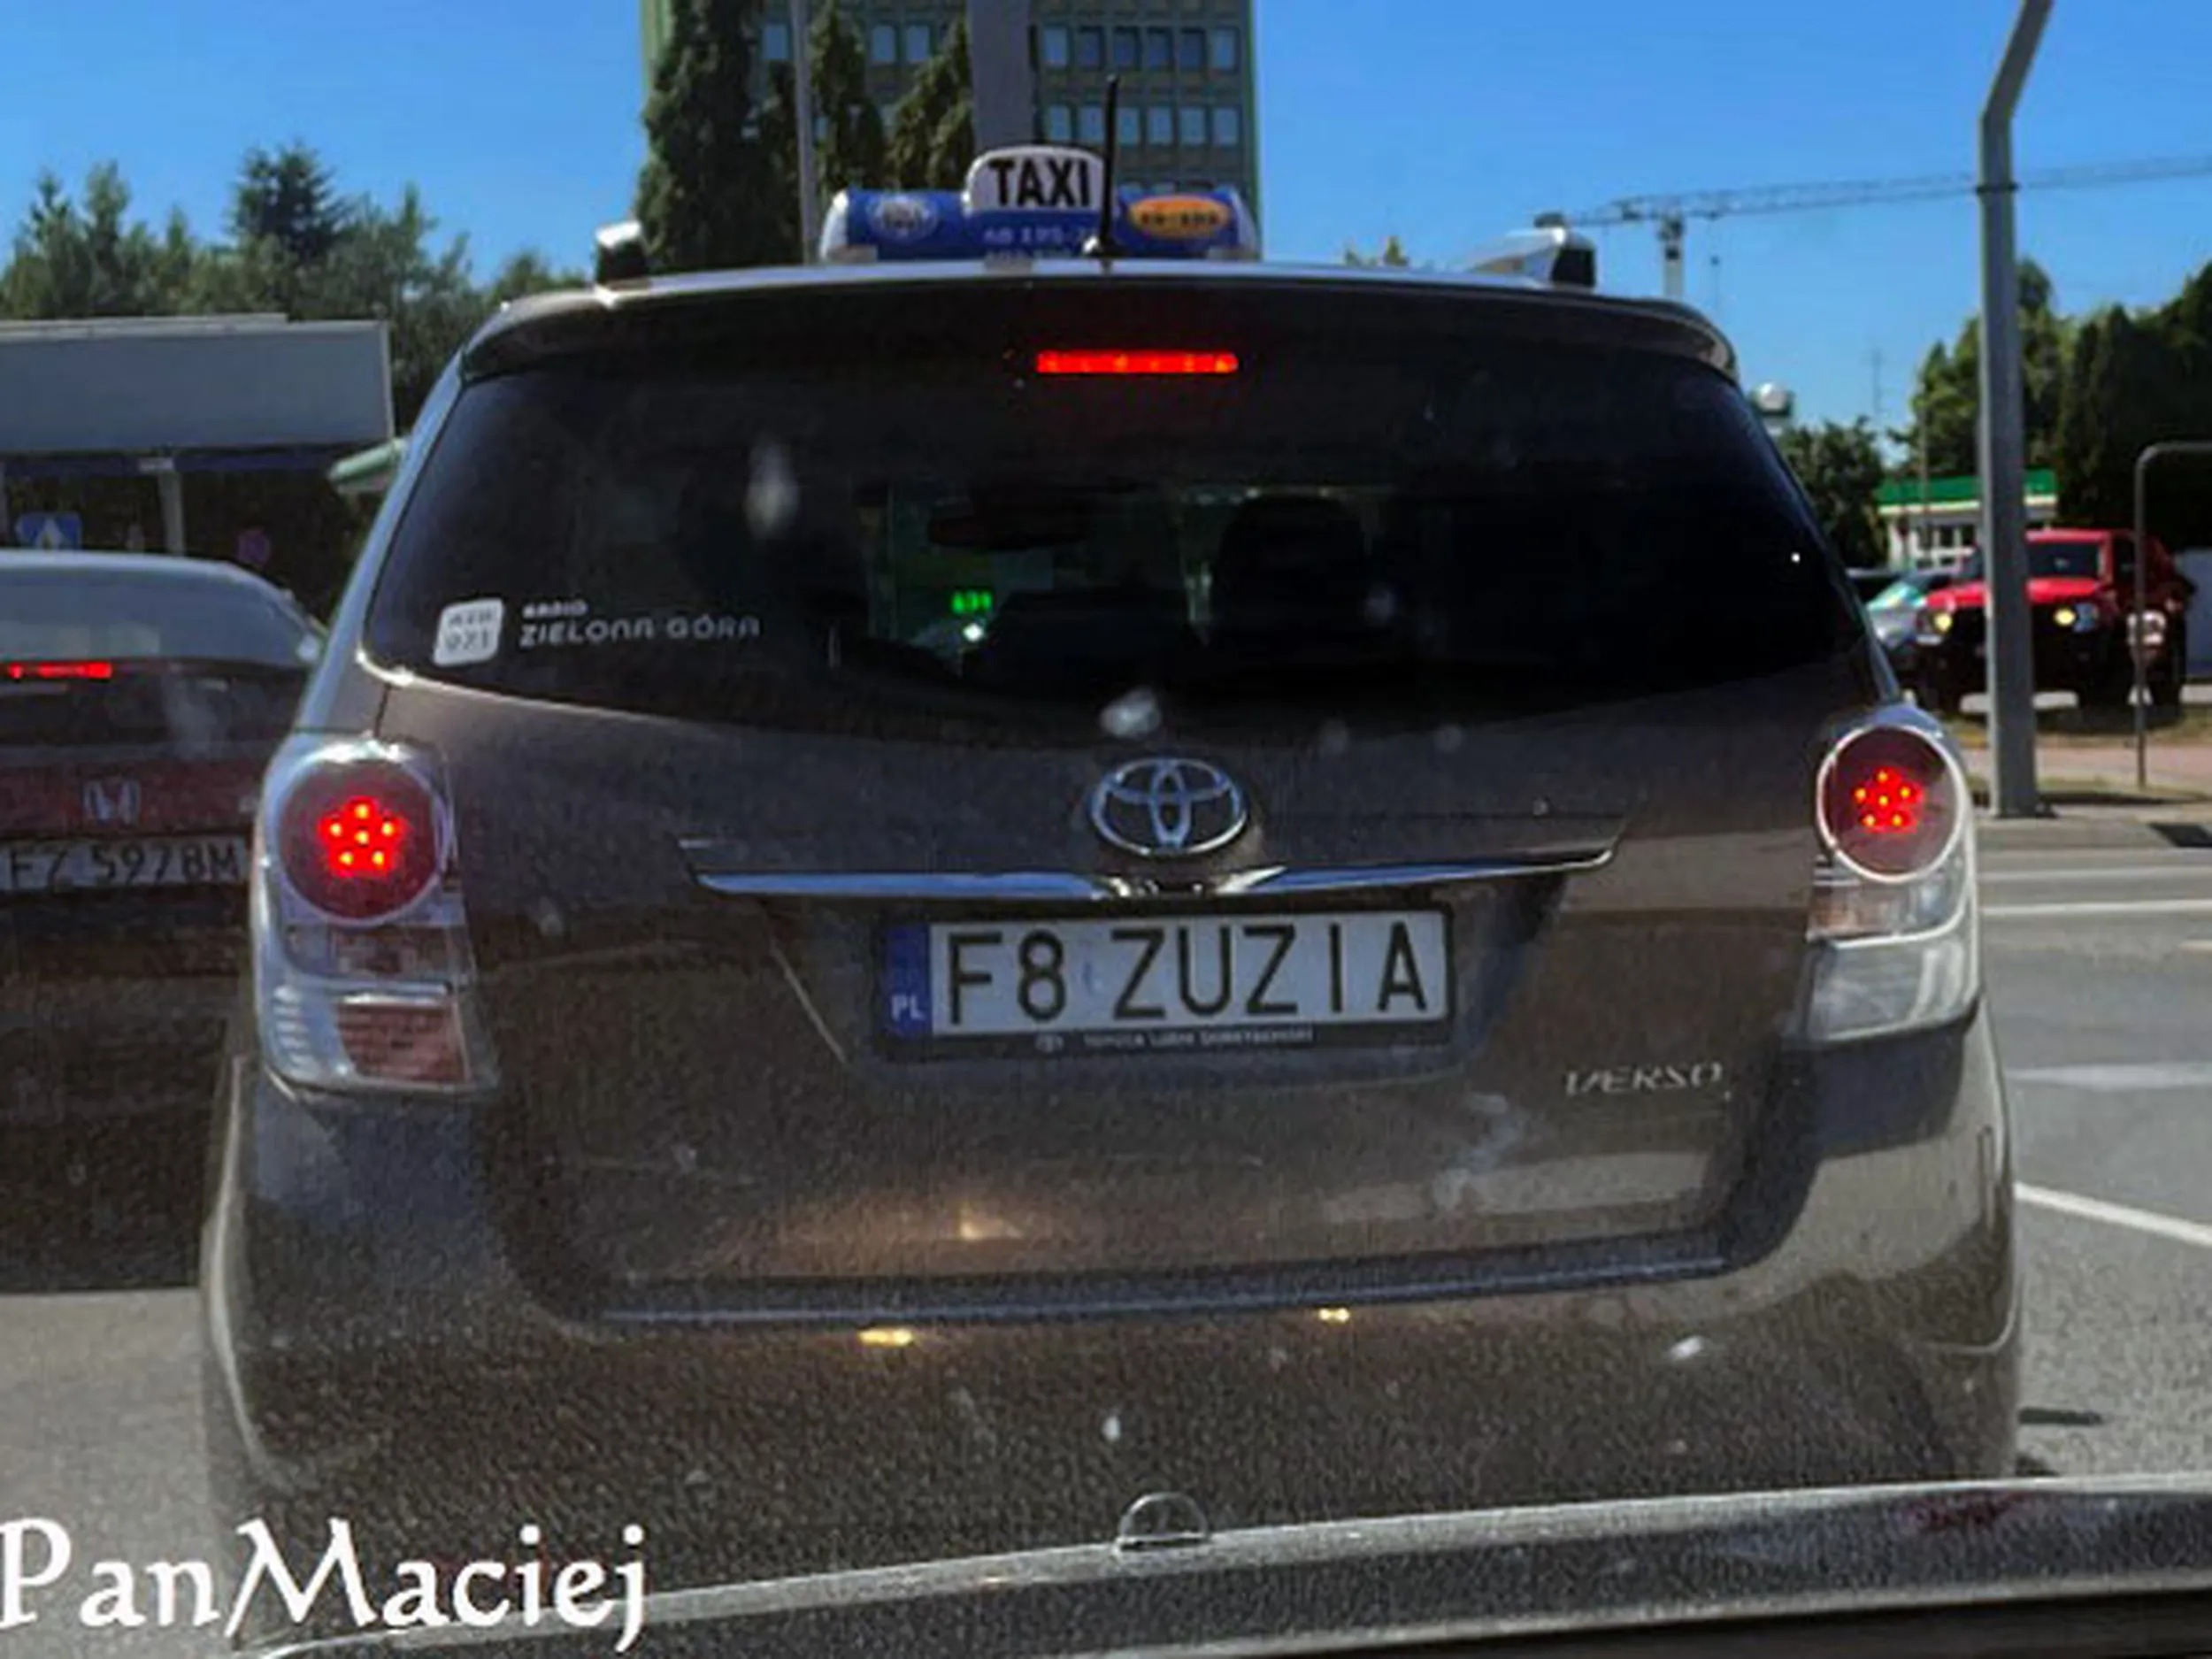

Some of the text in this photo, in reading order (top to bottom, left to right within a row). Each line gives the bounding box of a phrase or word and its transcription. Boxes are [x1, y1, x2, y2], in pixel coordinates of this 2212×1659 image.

[988, 157, 1090, 208] TAXI
[946, 922, 1427, 1025] F8 ZUZIA
[891, 994, 926, 1022] PL
[1565, 1061, 1724, 1096] VERSO
